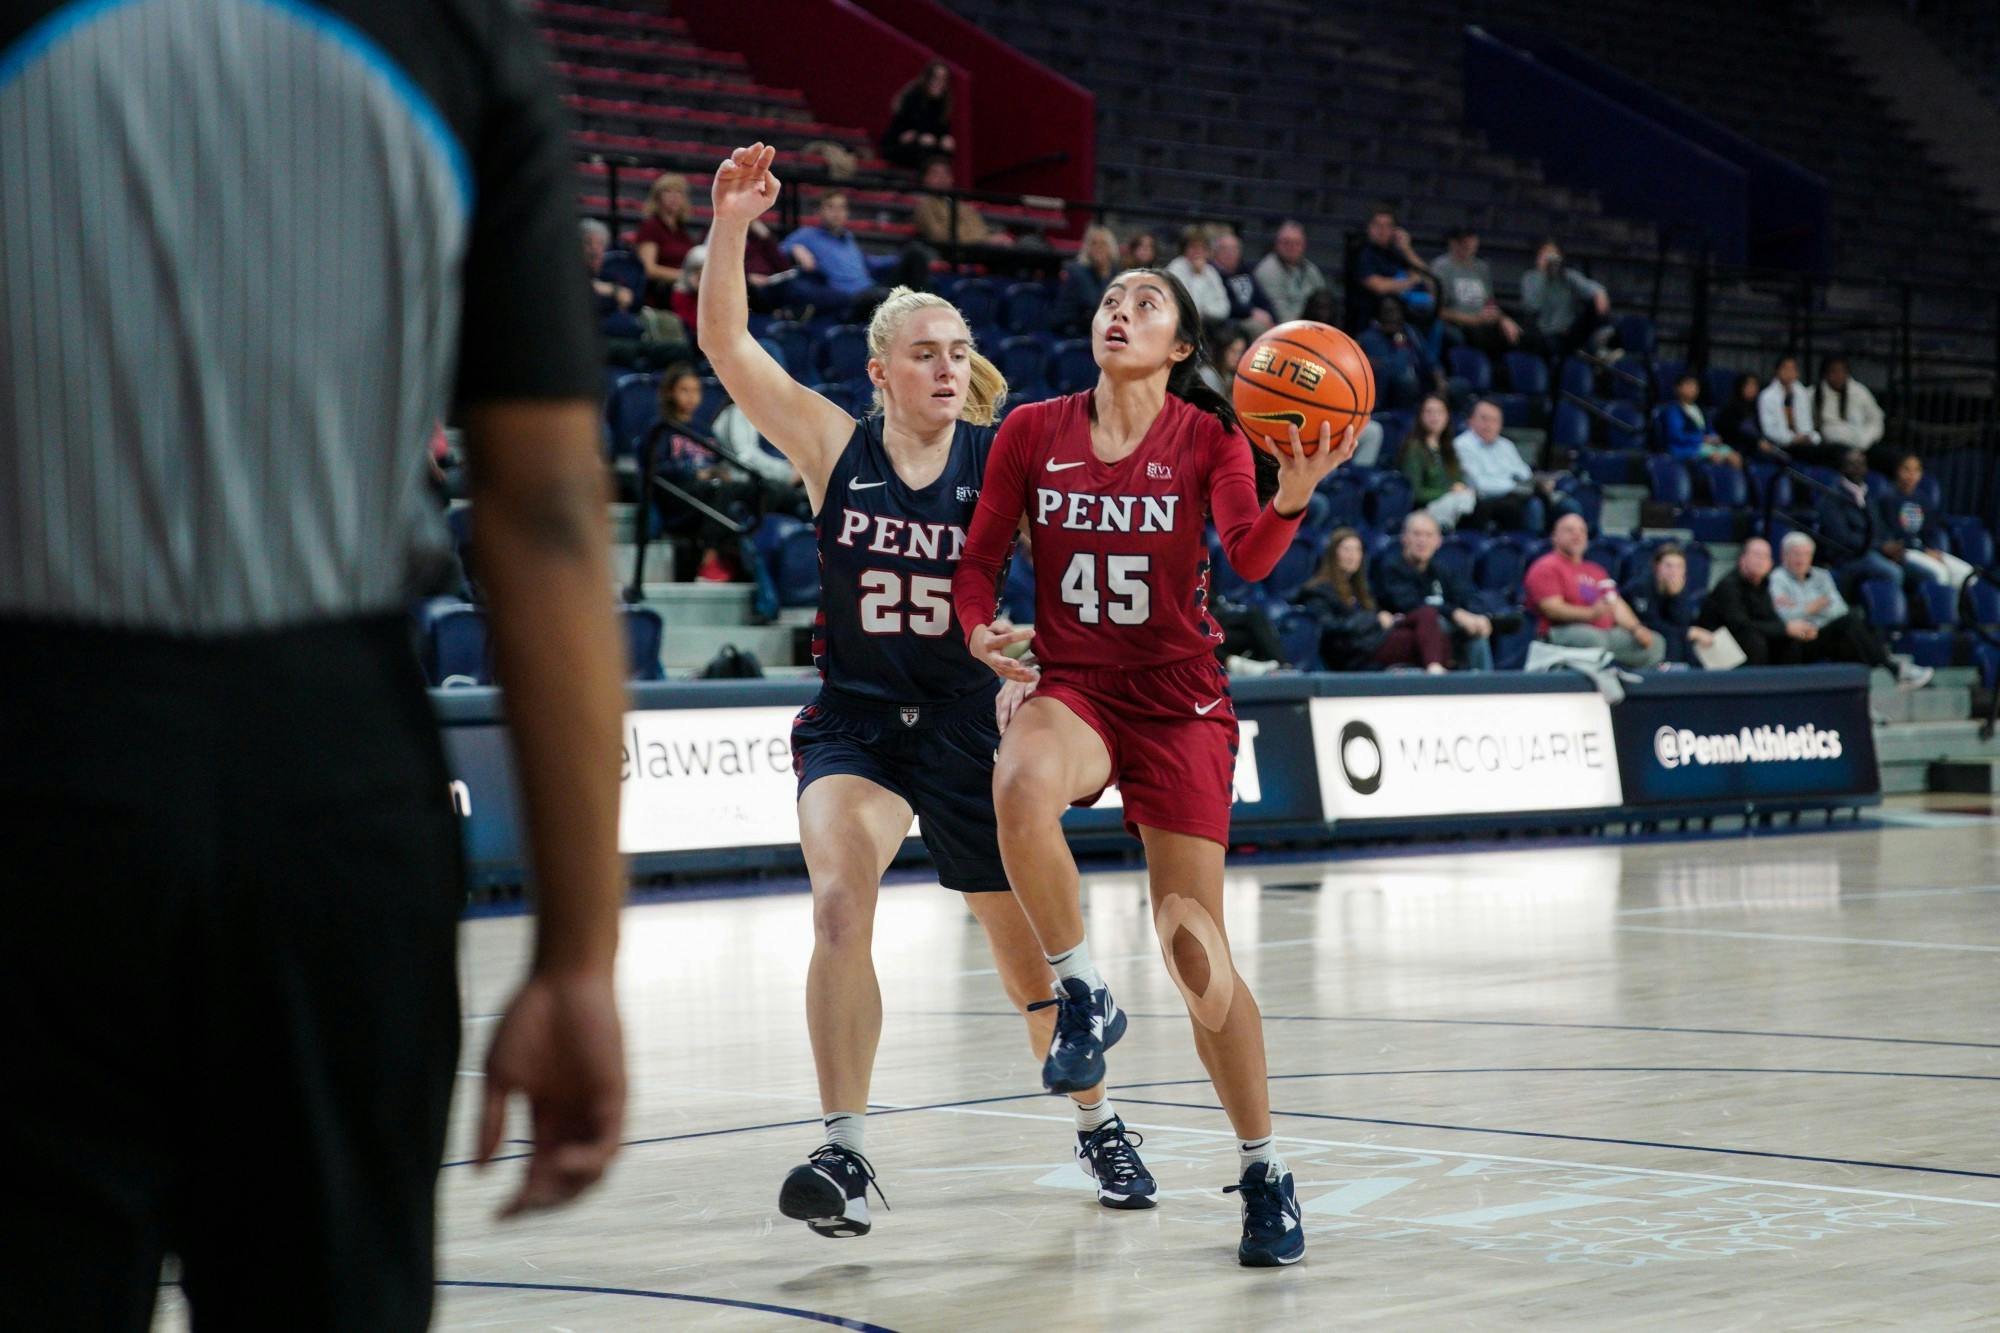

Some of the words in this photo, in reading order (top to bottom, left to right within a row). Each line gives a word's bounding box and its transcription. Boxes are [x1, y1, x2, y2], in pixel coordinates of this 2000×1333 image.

[1249, 347, 1325, 392] ELITE
[1036, 487, 1180, 533] PENN
[860, 569, 952, 636] 25
[1060, 552, 1150, 626] 45
[621, 727, 791, 783] elaware
[1400, 731, 1604, 773] MACQUARIE
[1653, 721, 1843, 770] @PennAthletics
